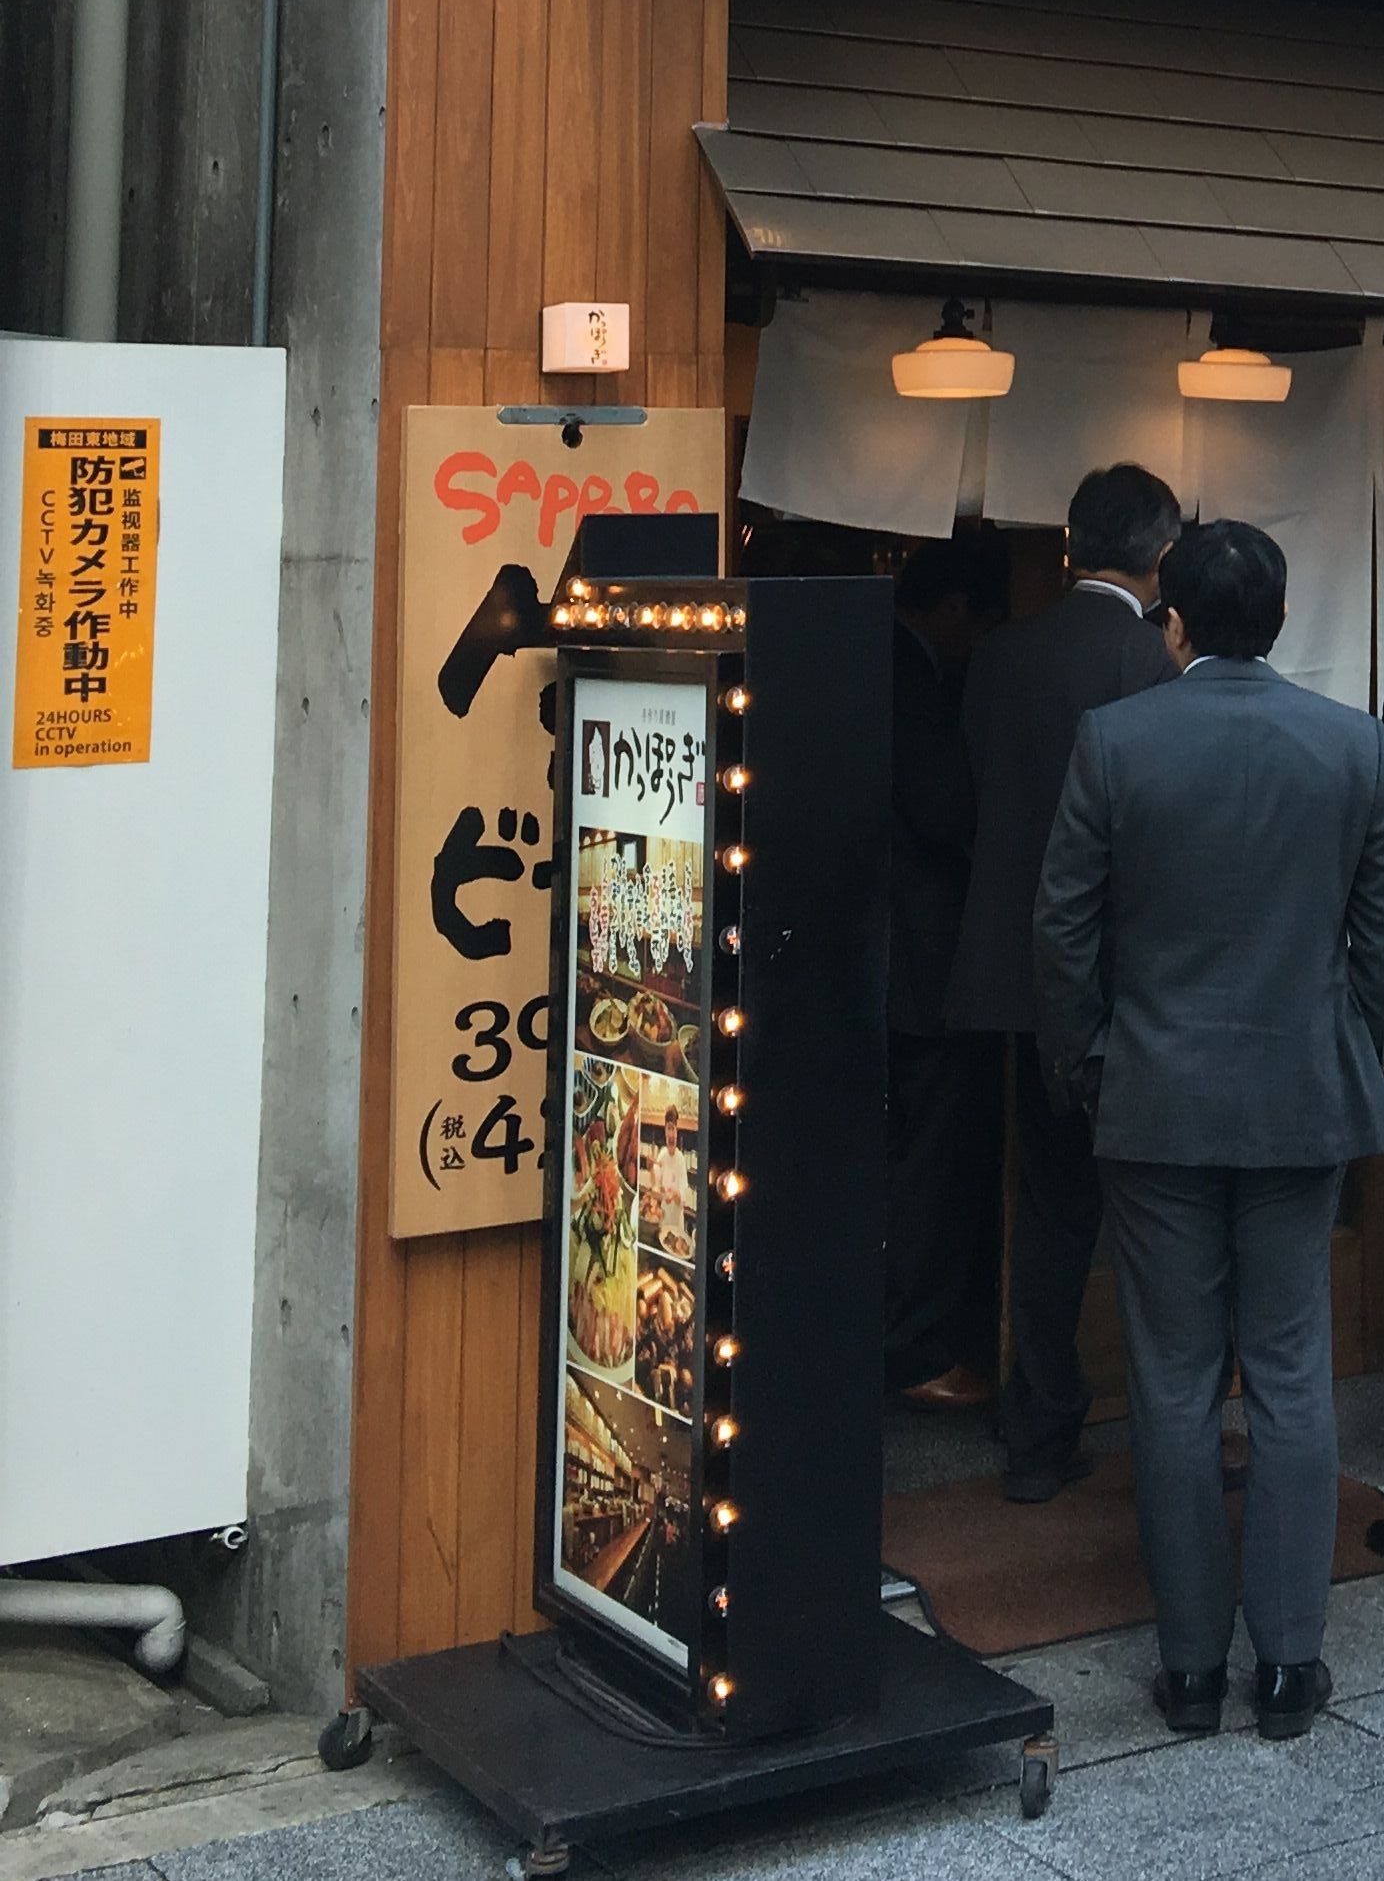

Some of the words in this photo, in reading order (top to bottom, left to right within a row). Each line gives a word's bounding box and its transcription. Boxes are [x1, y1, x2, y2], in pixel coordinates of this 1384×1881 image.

[119, 489, 143, 620] 监视器工作中
[62, 455, 116, 704] 防犯カメラ作動中
[36, 708, 113, 726] 24HOURS
[35, 726, 77, 742] CCTV
[34, 740, 50, 756] in
[54, 739, 132, 758] operation
